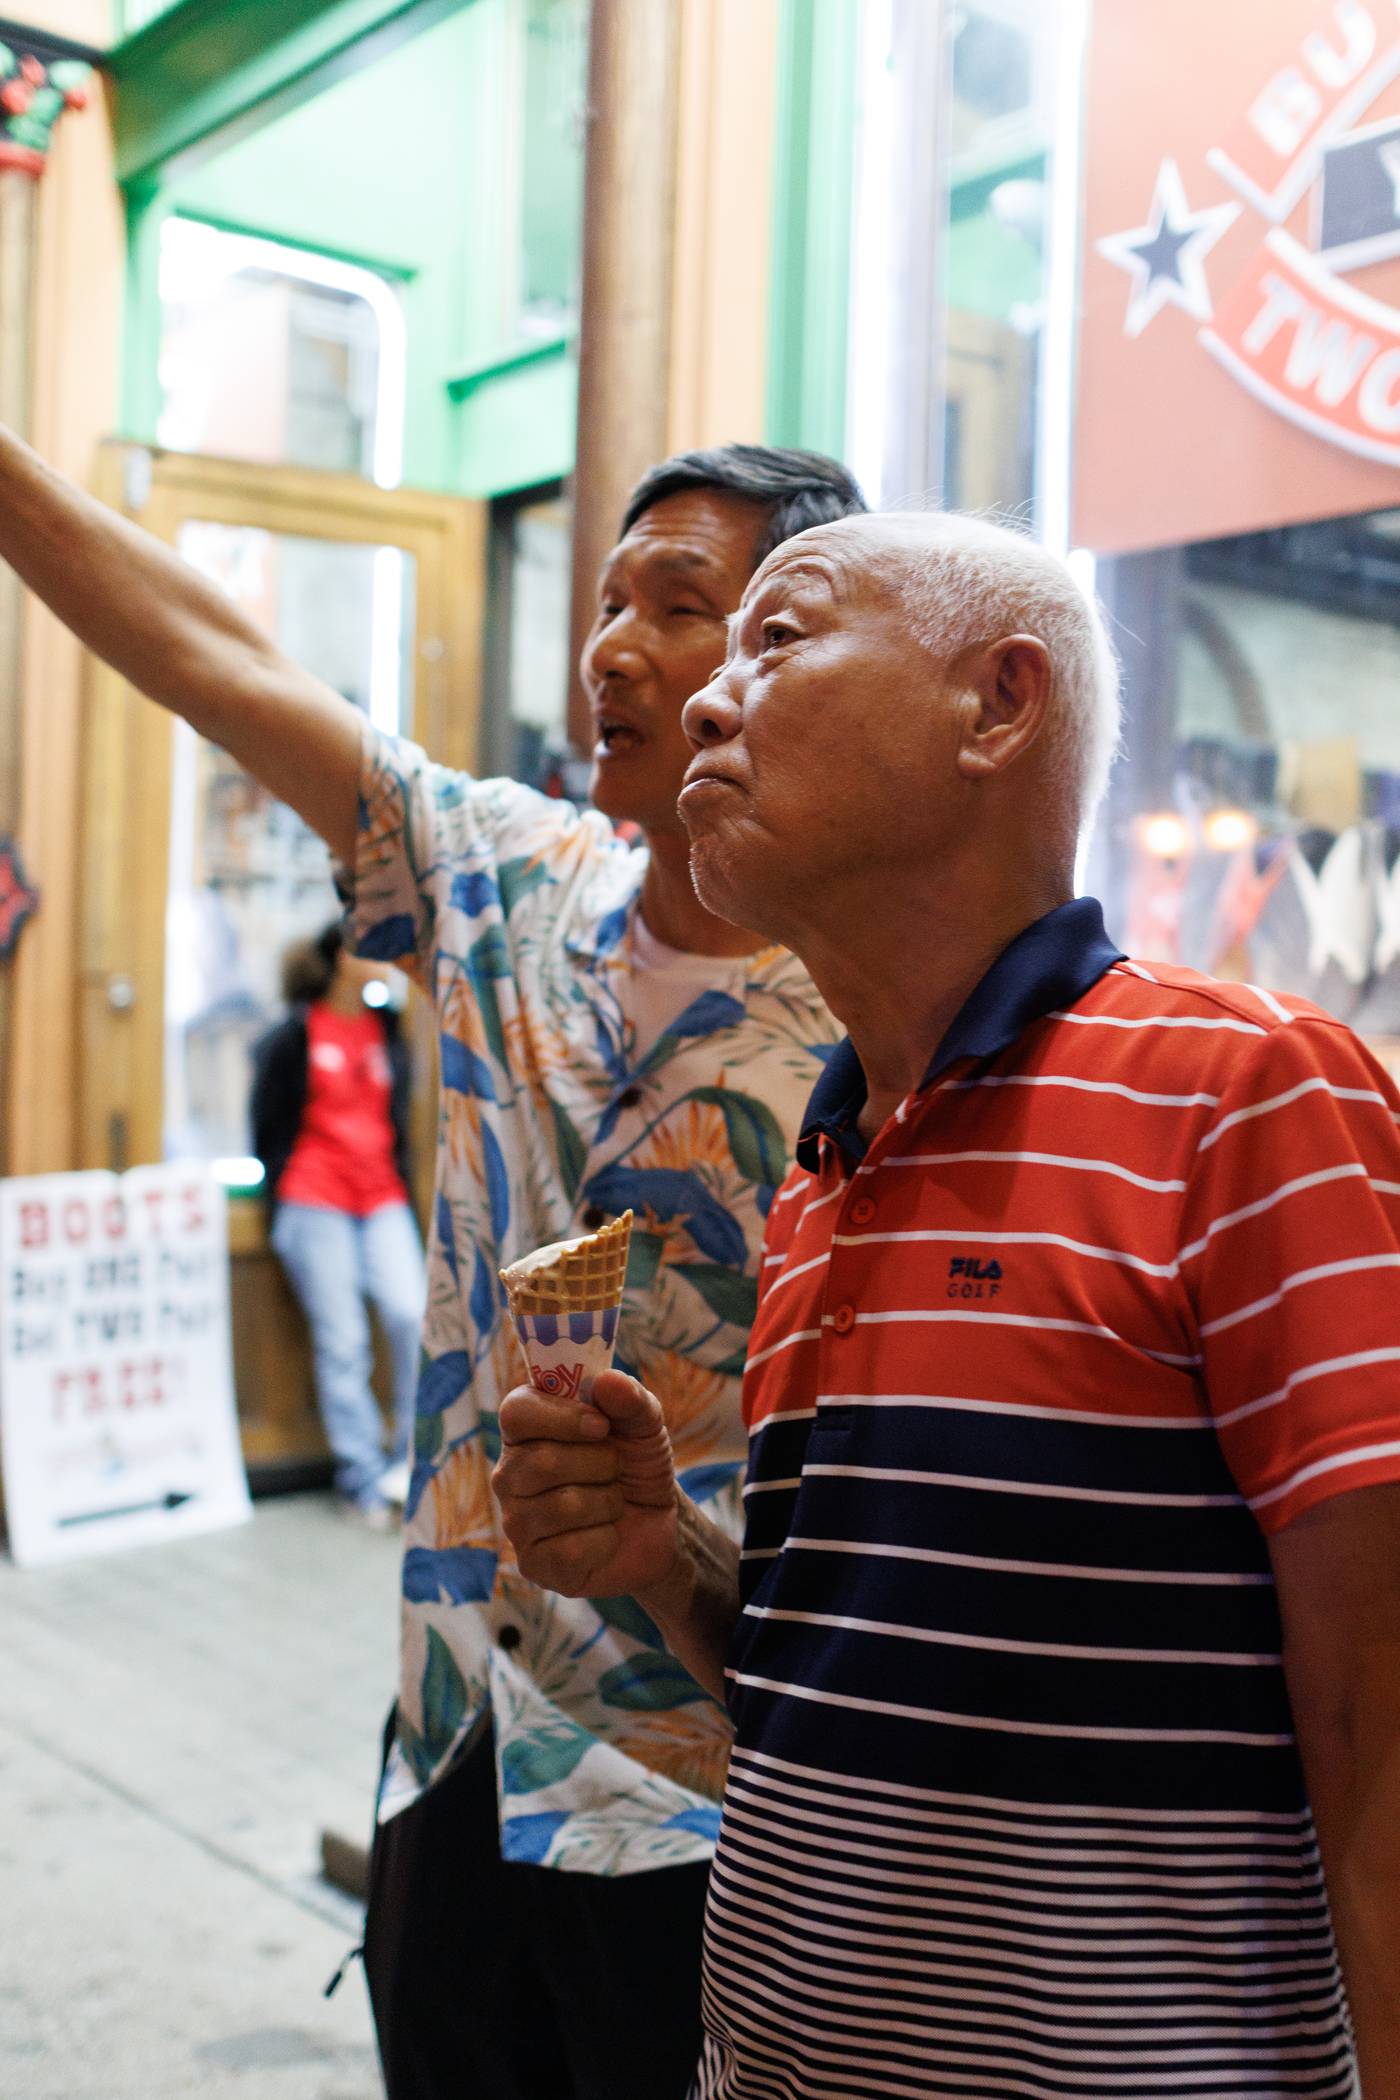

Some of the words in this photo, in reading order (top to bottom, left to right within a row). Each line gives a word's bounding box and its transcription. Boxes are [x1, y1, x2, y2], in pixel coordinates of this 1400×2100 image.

[1250, 0, 1400, 156] BU
[19, 1187, 205, 1249] BOOTS
[948, 1257, 1003, 1280] FILA
[947, 1282, 1001, 1299] GOLF
